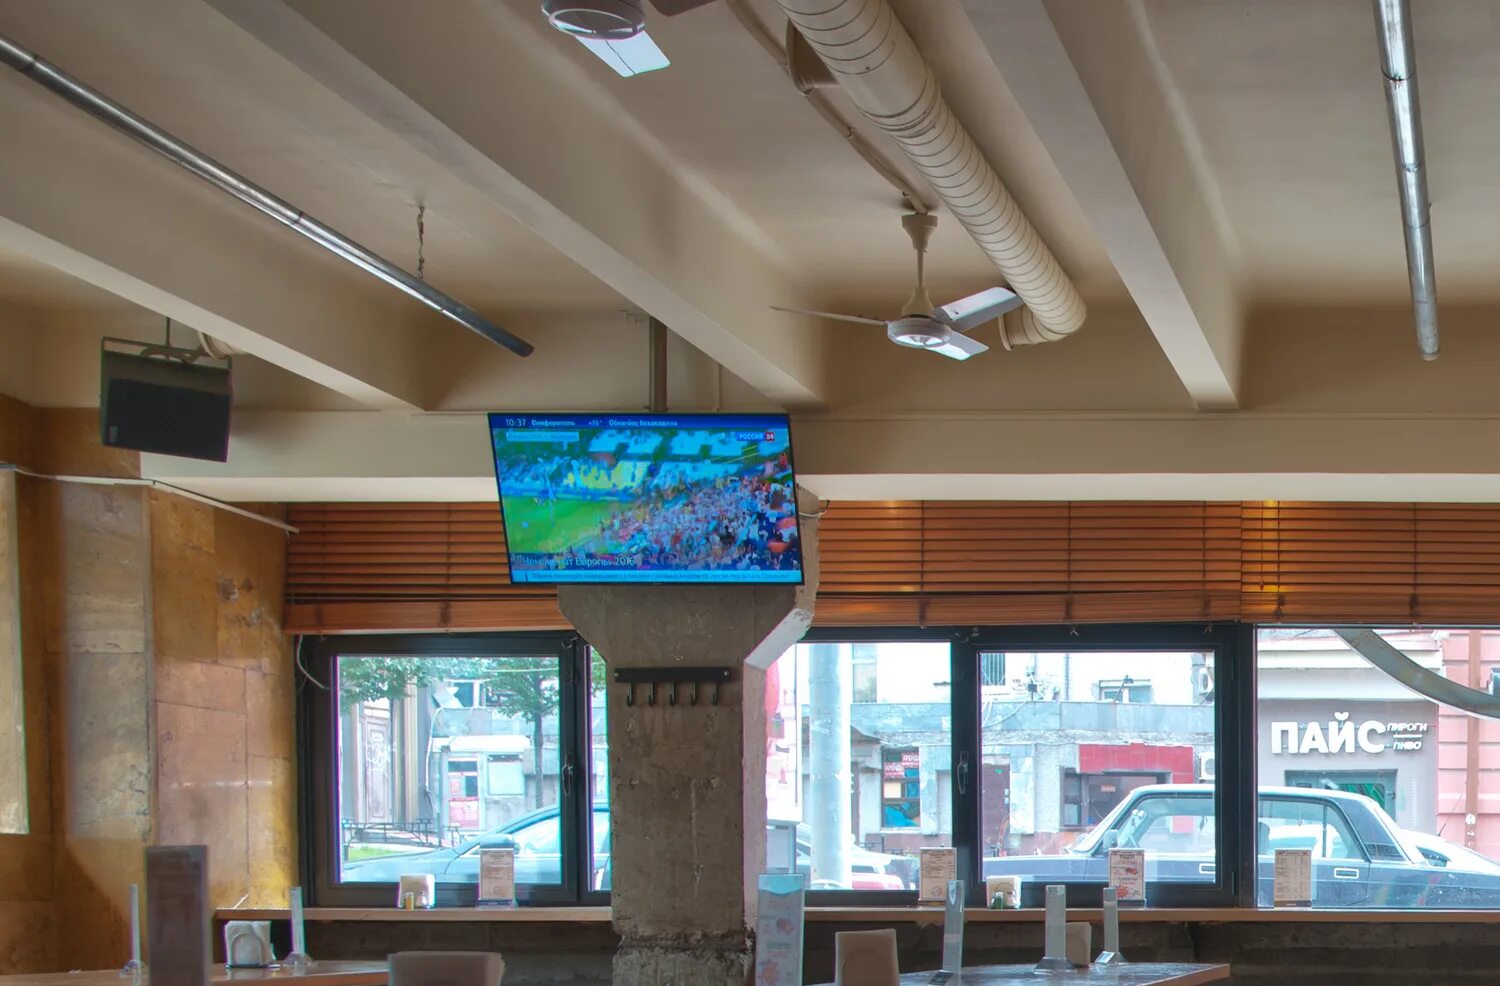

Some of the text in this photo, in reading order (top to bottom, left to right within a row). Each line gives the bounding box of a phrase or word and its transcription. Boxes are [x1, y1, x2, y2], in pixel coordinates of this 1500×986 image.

[506, 418, 526, 427] 10:37
[1271, 711, 1386, 754] ПАЙС
[1387, 722, 1428, 733] ПИРОГИ
[1393, 741, 1422, 751] ПИВО
